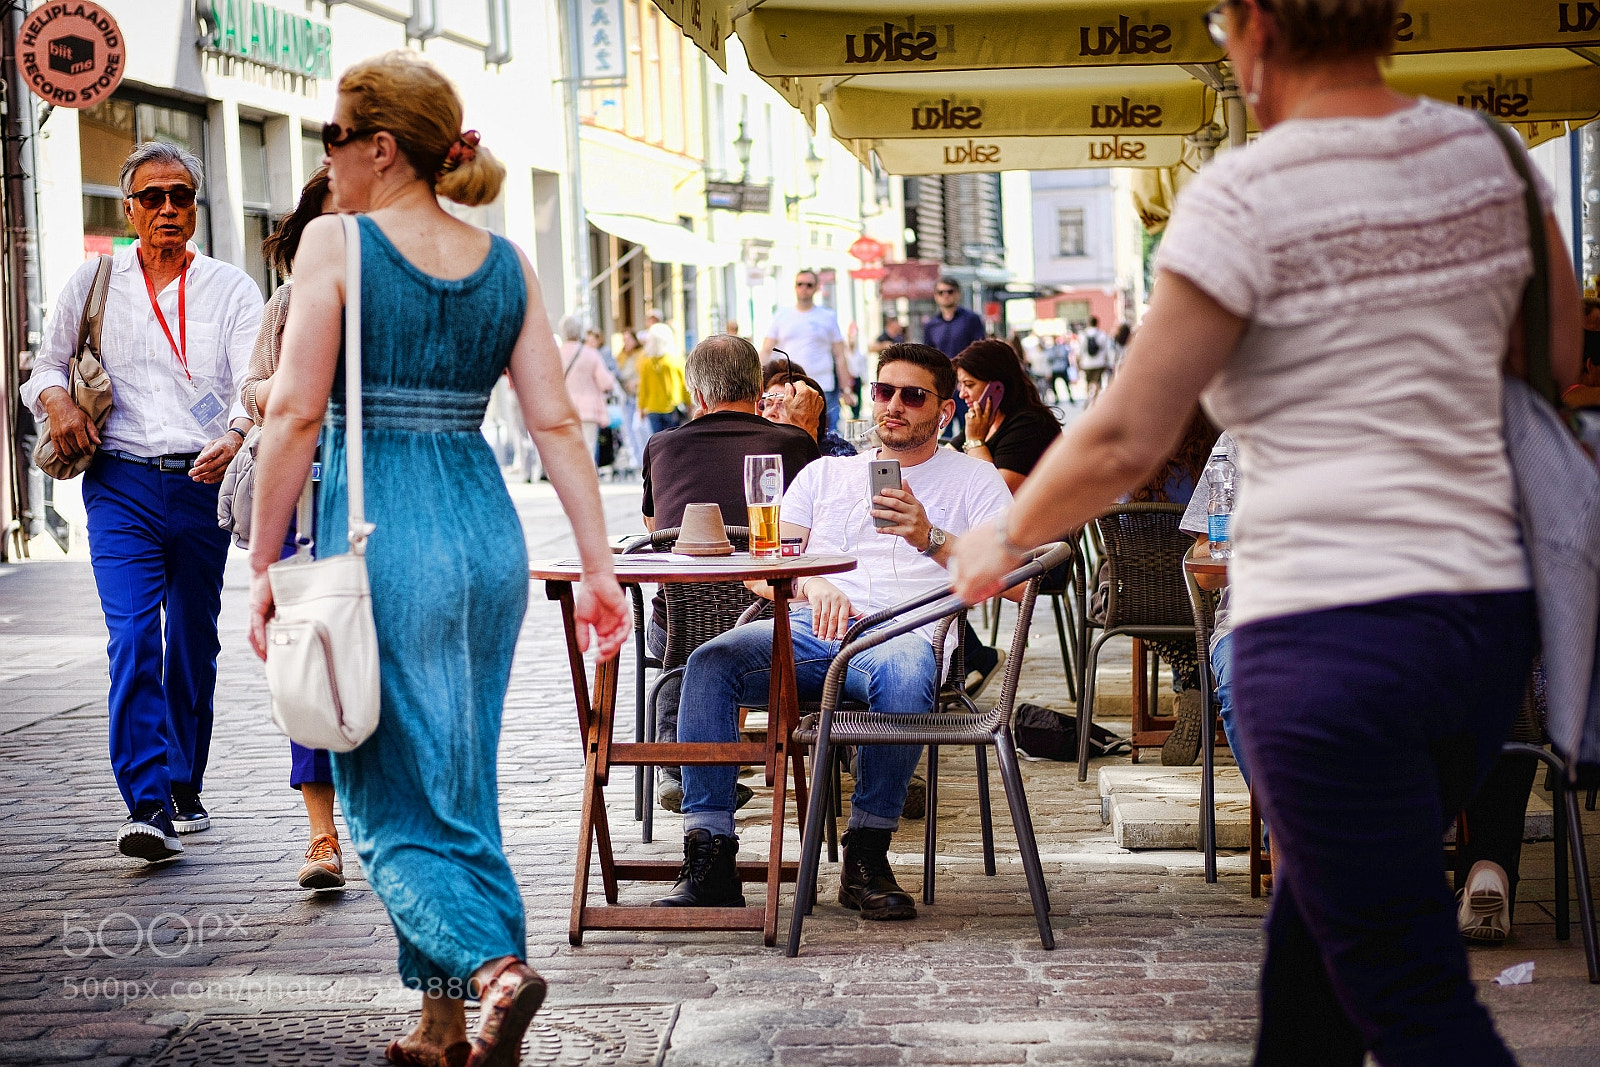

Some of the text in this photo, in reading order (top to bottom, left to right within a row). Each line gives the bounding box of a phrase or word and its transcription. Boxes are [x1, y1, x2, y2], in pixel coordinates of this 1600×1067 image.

[23, 4, 118, 49] HELIPLAADID
[23, 52, 120, 102] RECORD STORE
